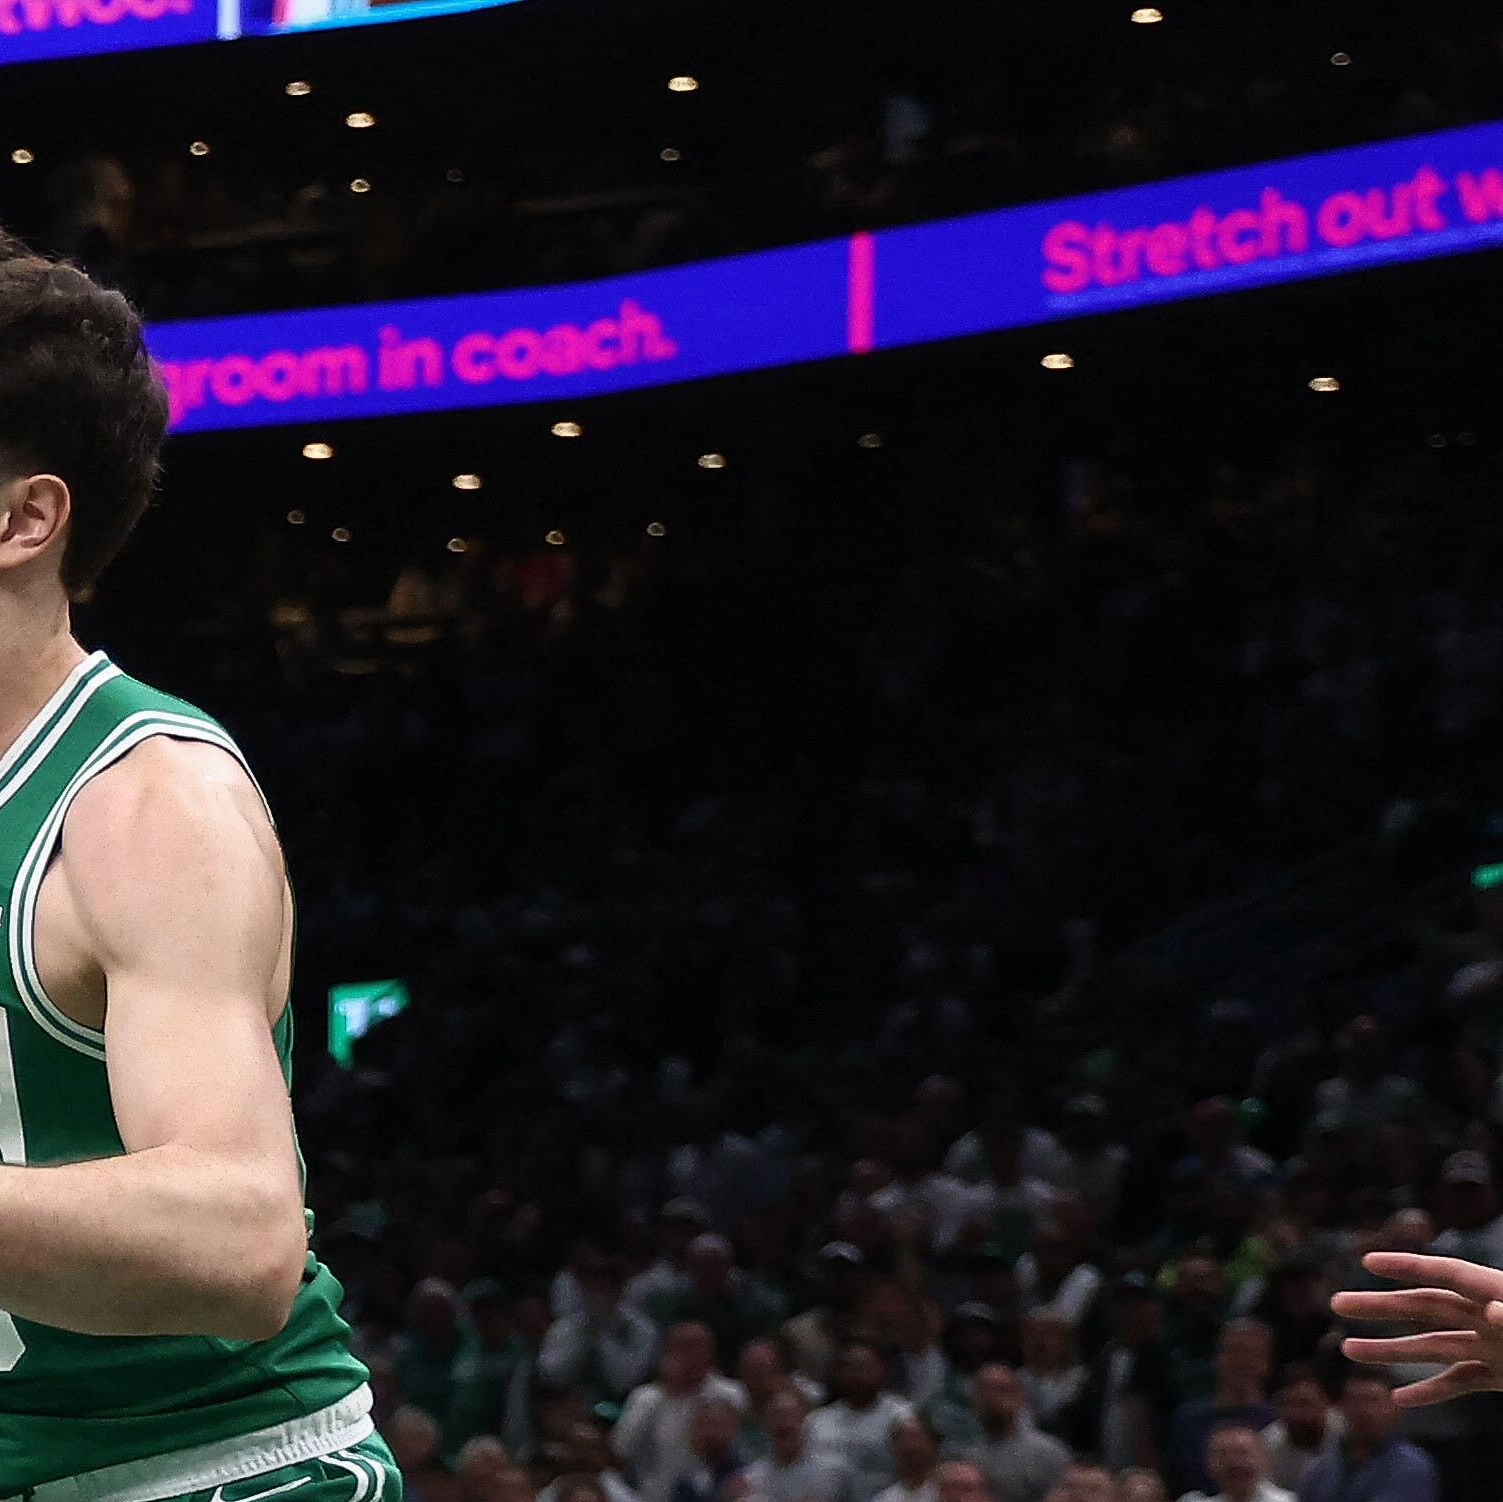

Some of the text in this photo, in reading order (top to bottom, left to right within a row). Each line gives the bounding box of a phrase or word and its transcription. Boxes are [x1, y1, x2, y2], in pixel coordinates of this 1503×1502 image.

[1043, 187, 1308, 293] Stretch
[1317, 168, 1447, 248] out
[378, 325, 444, 390] in
[451, 300, 678, 384] coach.
